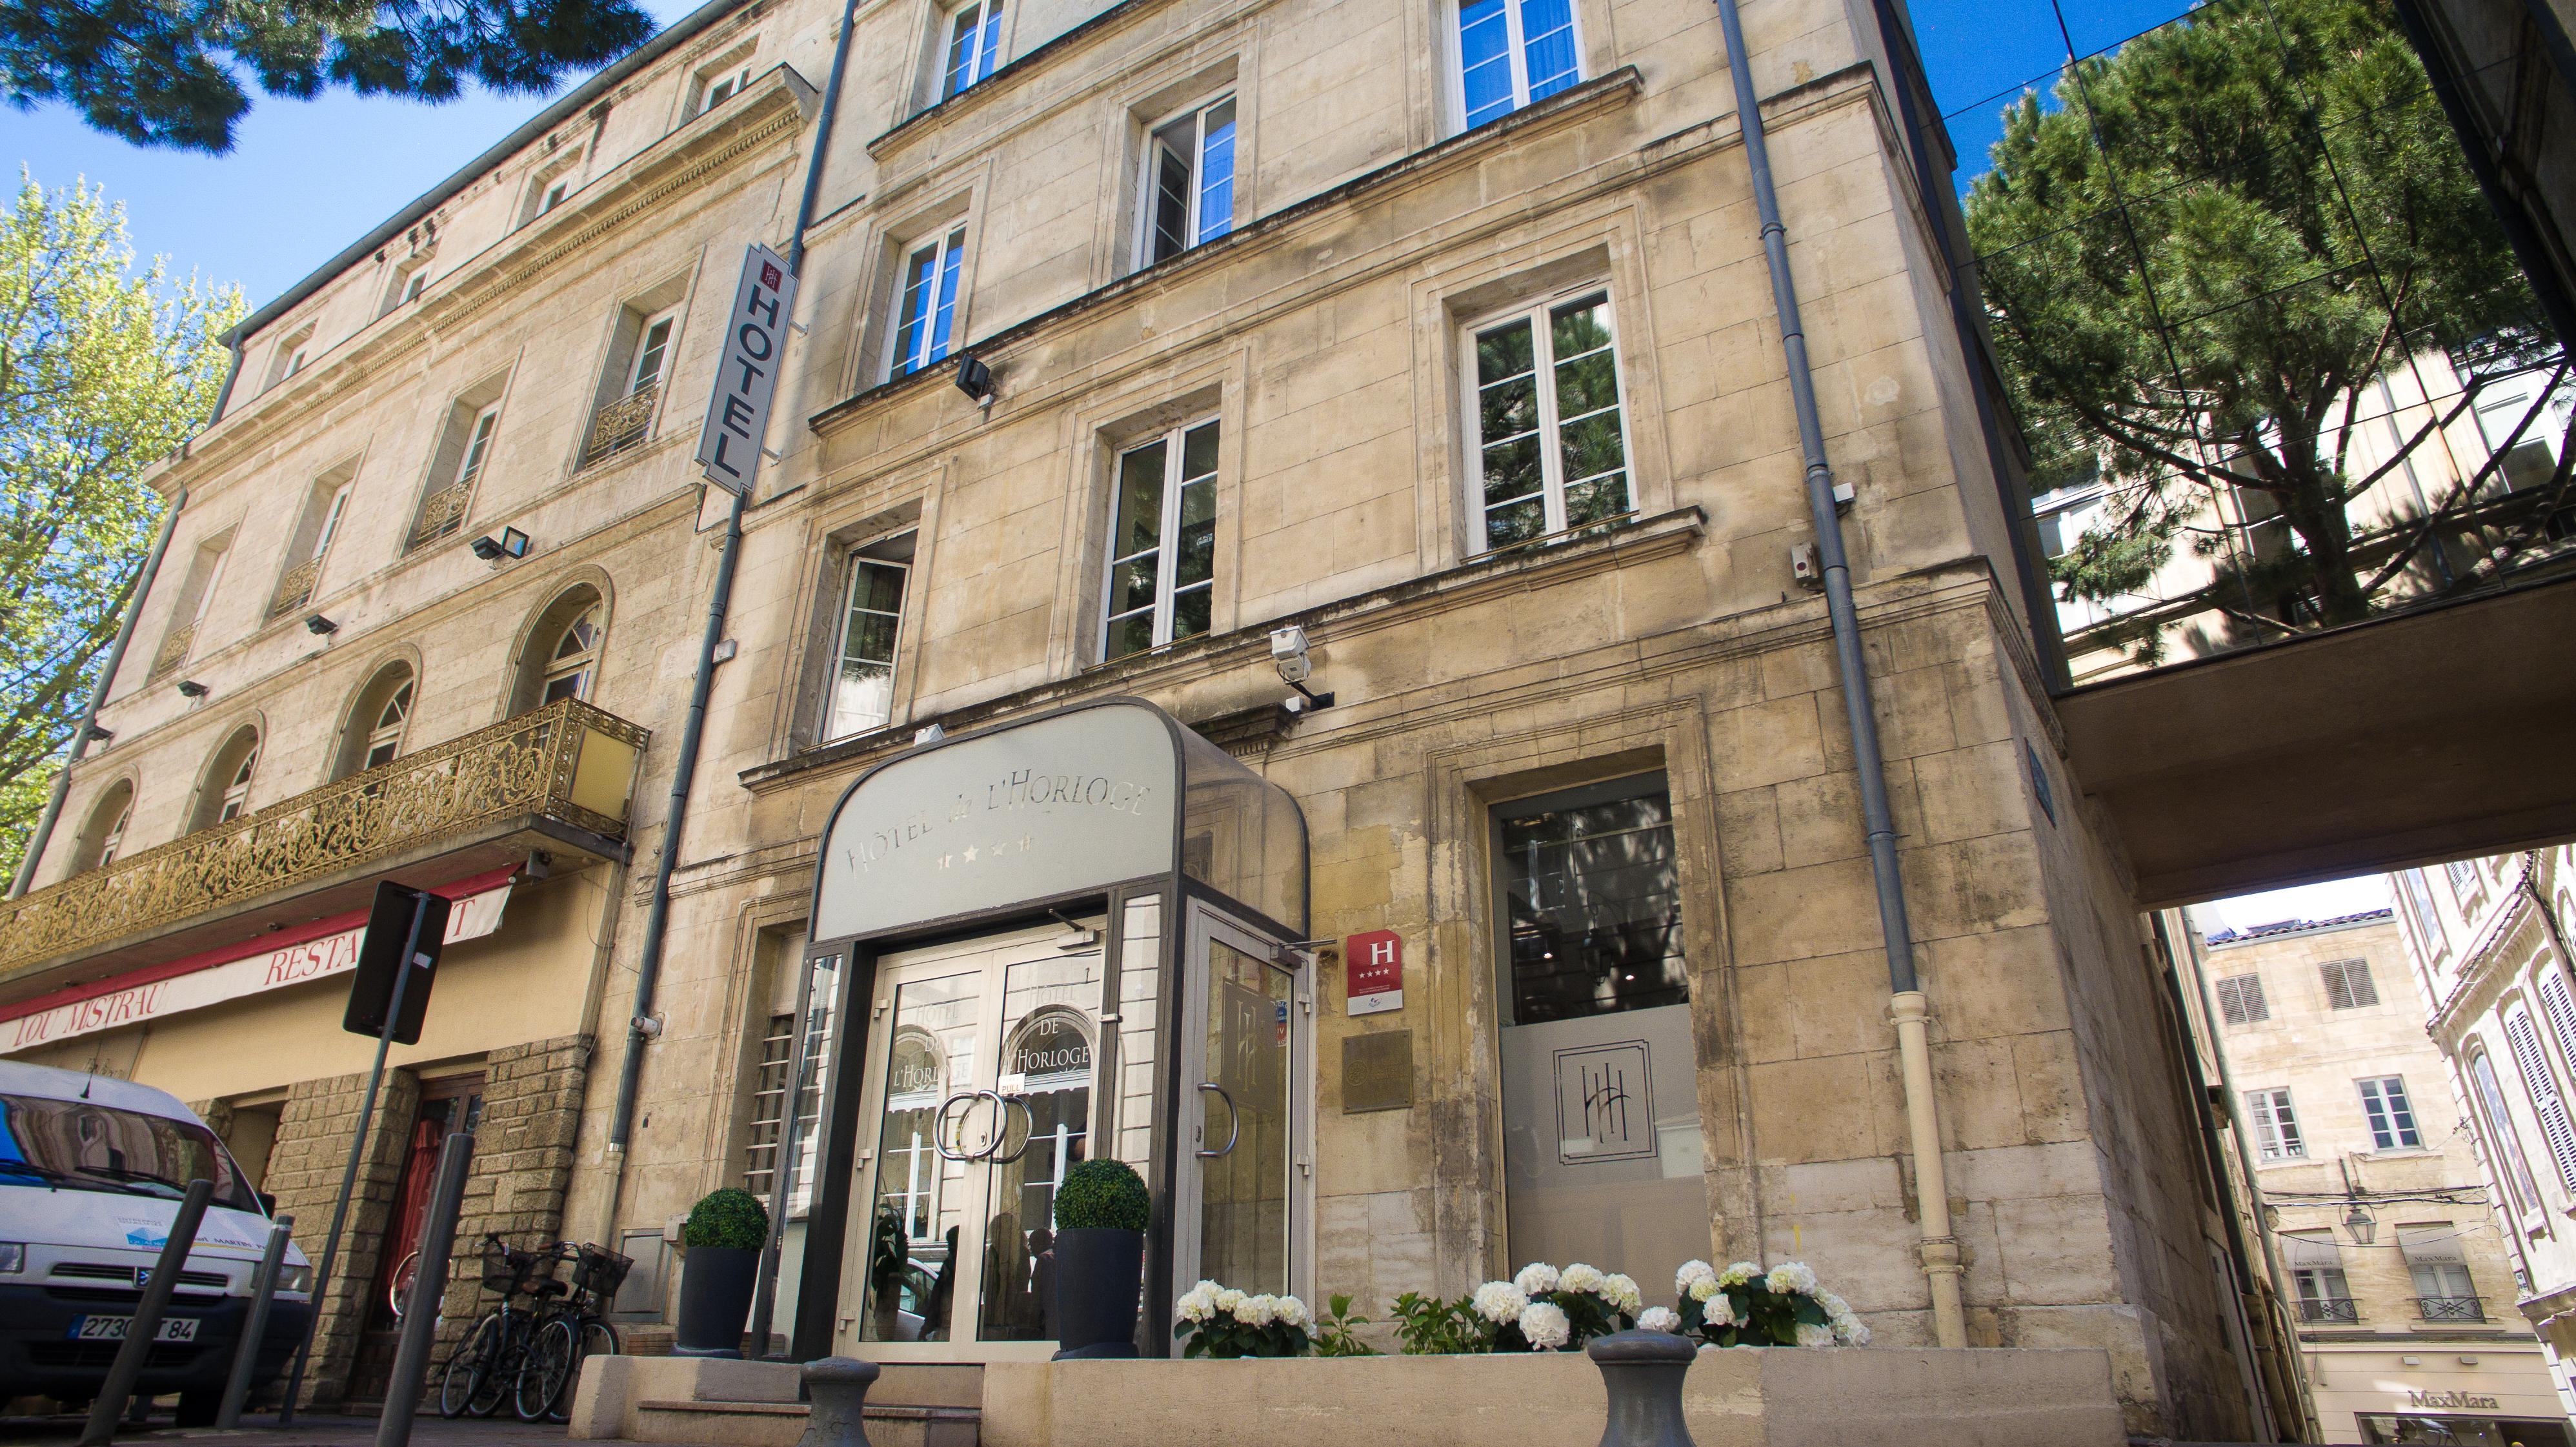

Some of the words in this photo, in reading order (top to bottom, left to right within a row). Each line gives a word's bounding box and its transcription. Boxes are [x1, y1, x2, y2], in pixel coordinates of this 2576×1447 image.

[713, 284, 780, 479] HOTEL
[987, 768, 1151, 816] L'HORLOGE
[1369, 940, 1394, 966] H
[13, 1011, 59, 1047] LOU
[63, 981, 170, 1033] MISTRAU
[1040, 1018, 1059, 1035] DE
[925, 1037, 941, 1052] DE
[894, 1061, 969, 1088] L'HORLOGE
[1001, 1084, 1020, 1093] PULL
[214, 1238, 252, 1248] MARTIN
[2294, 1259, 2334, 1267] MaxMara
[168, 1320, 194, 1339] 84
[2408, 1390, 2500, 1409] MaxMara
